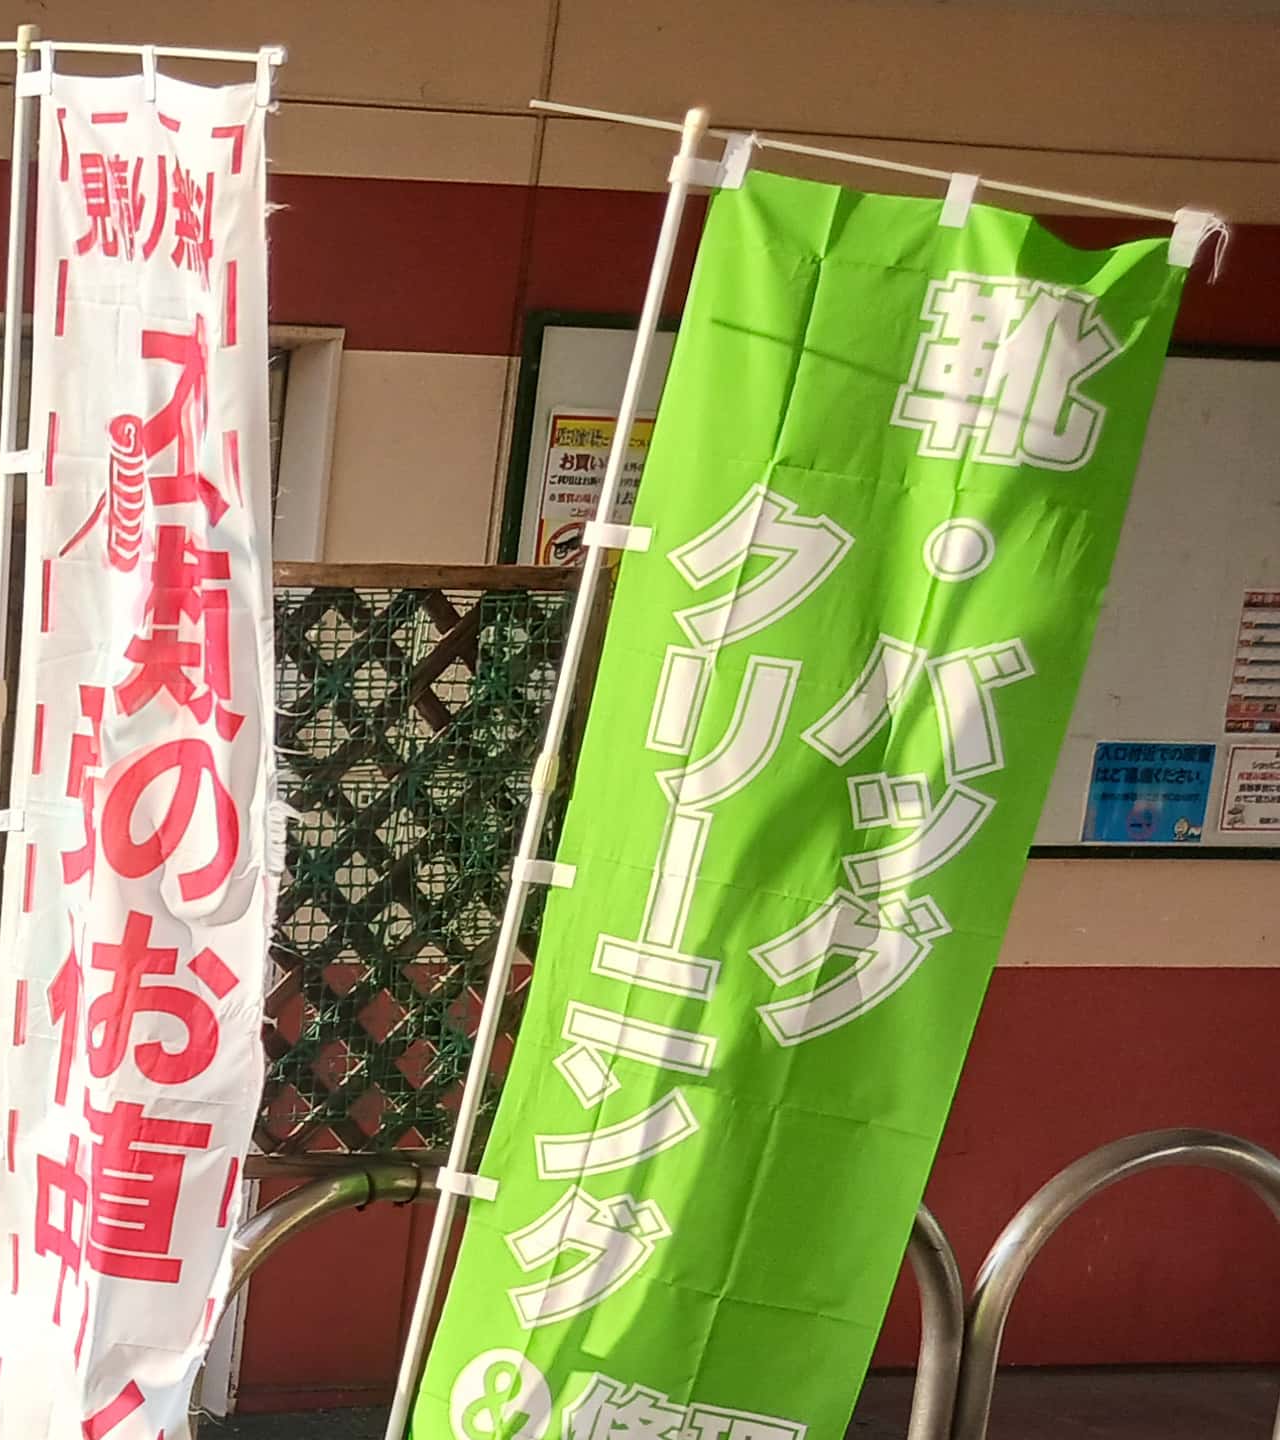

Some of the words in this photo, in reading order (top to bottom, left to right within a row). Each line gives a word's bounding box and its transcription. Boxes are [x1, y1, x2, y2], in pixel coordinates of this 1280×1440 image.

[504, 482, 856, 1330] クリーニング
[748, 270, 1124, 1047] 靴・バッグ
